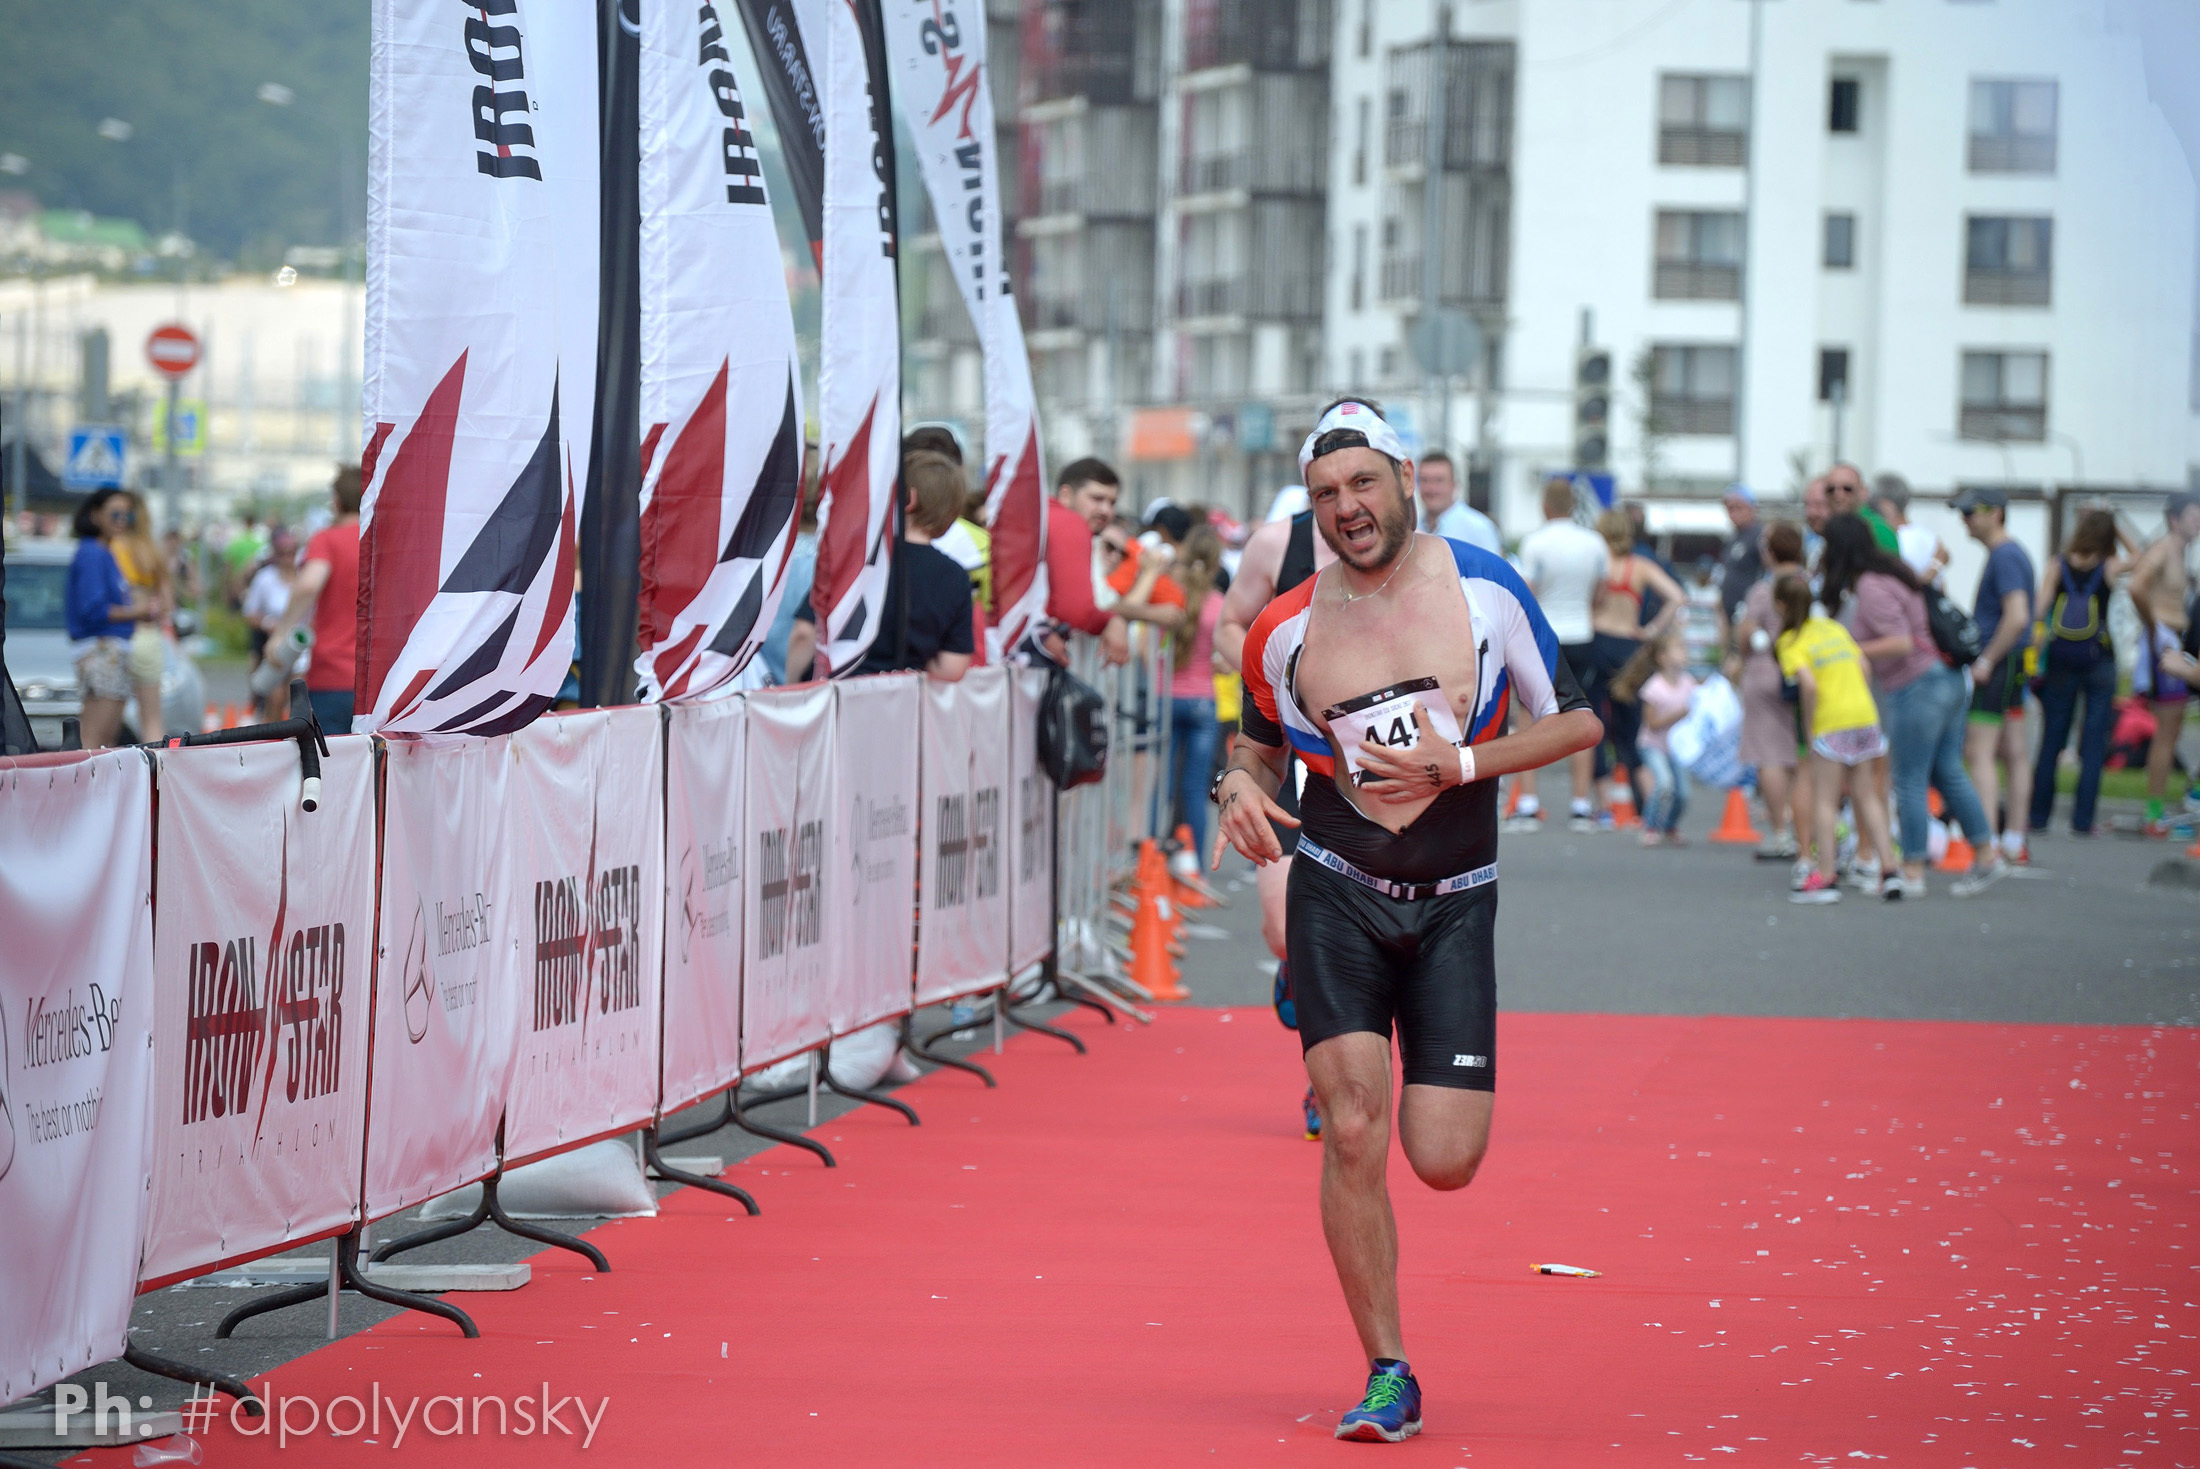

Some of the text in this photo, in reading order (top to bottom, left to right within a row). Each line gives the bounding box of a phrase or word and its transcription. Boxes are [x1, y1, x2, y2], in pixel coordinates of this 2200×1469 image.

[1424, 763, 1442, 788] 445
[1322, 853, 1379, 889] ABU DHABI
[1450, 867, 1496, 891] ABU DHABI
[534, 864, 640, 1032] IRON STAR
[183, 922, 345, 1126] IRON STAR
[40, 1099, 62, 1143] best
[61, 1103, 74, 1136] or
